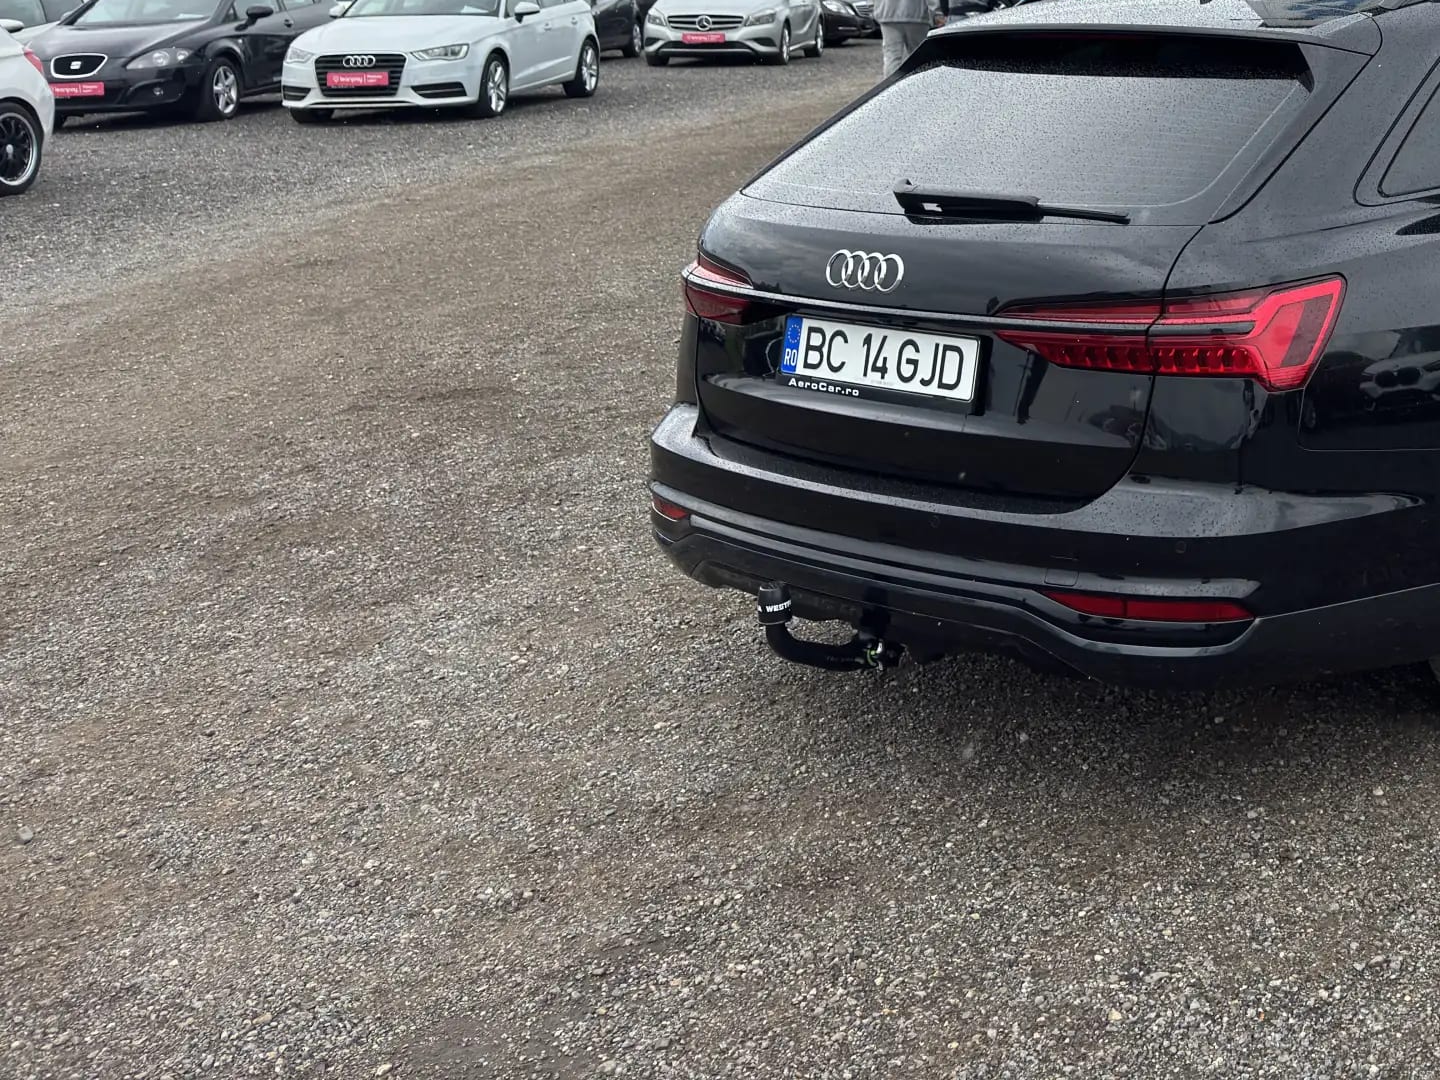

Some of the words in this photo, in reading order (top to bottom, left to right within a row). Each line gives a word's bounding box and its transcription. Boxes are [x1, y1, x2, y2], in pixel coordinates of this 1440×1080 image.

[784, 348, 797, 366] RO
[803, 326, 848, 373] BC
[788, 377, 860, 397] AeroCar.ro
